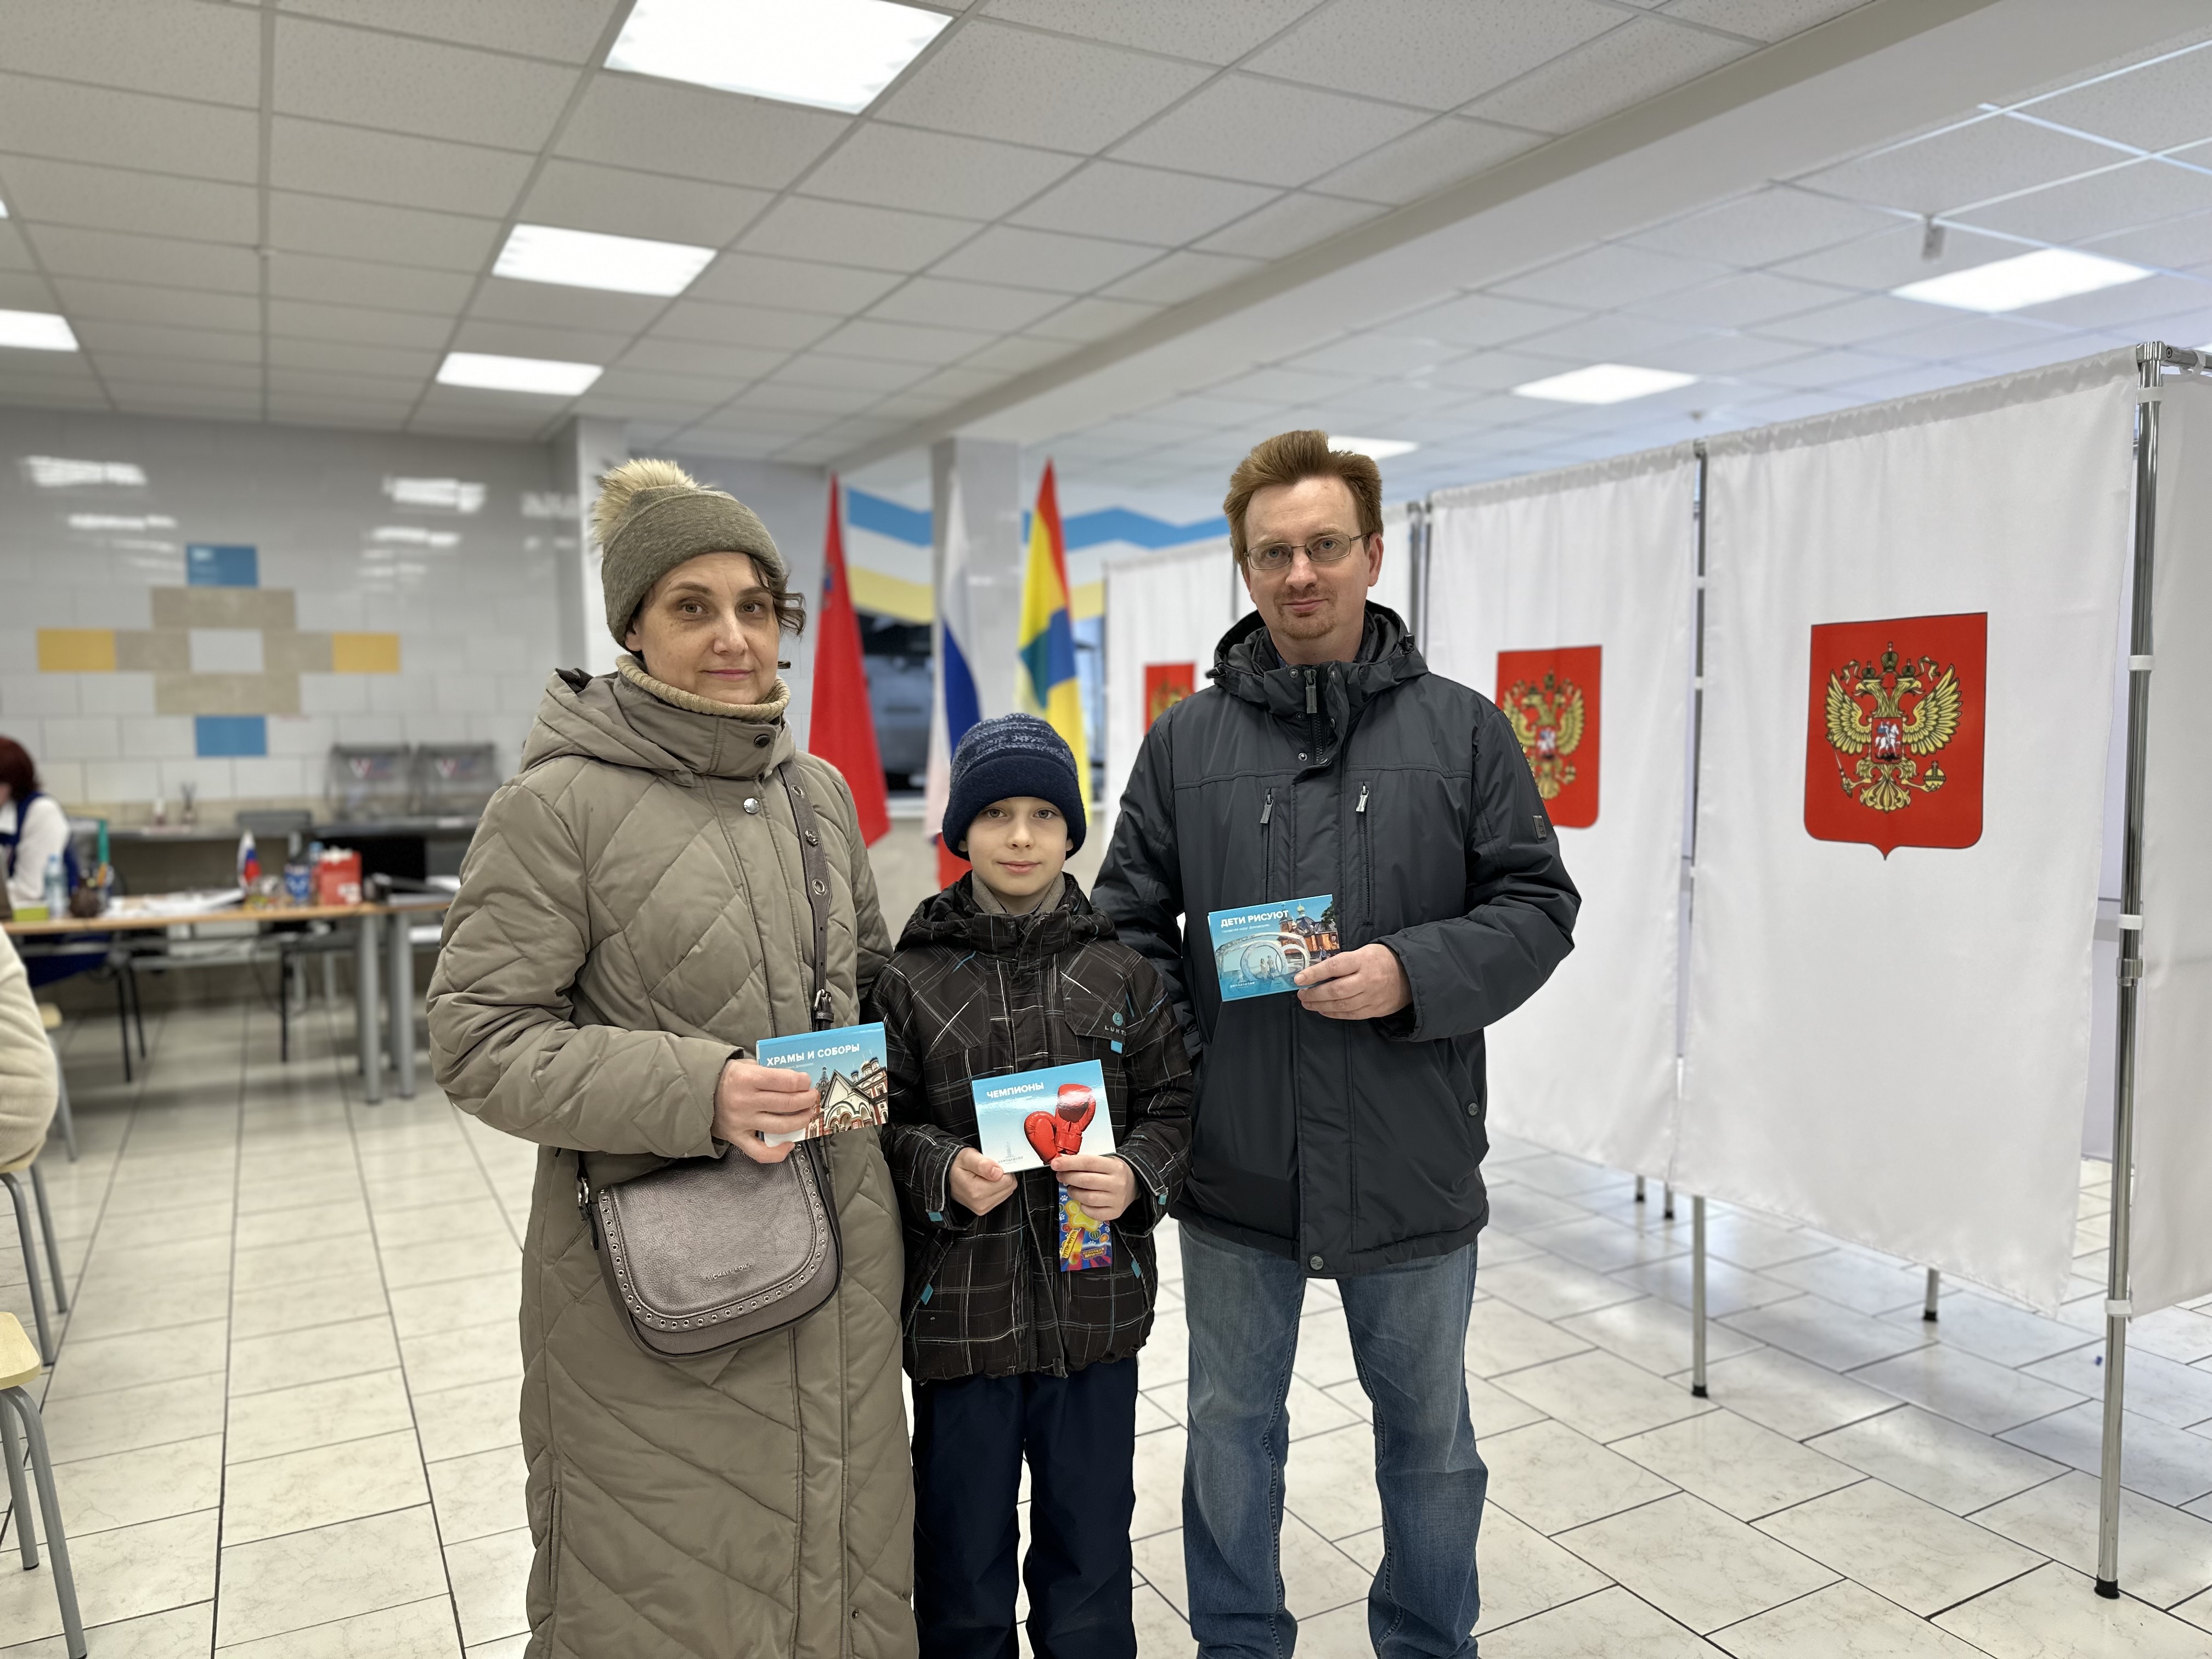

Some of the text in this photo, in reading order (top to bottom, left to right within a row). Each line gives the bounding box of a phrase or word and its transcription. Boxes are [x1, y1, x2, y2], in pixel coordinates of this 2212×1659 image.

[1221, 910, 1289, 928] ДЕТИ РИСУЮТ
[767, 1053, 804, 1066] ХРАМЫ
[808, 1051, 815, 1059] И
[817, 1043, 860, 1058] СОБОРЫ
[986, 1081, 1045, 1098] ЧЕМПИОНЫ
[706, 1268, 731, 1282] ICHAEL
